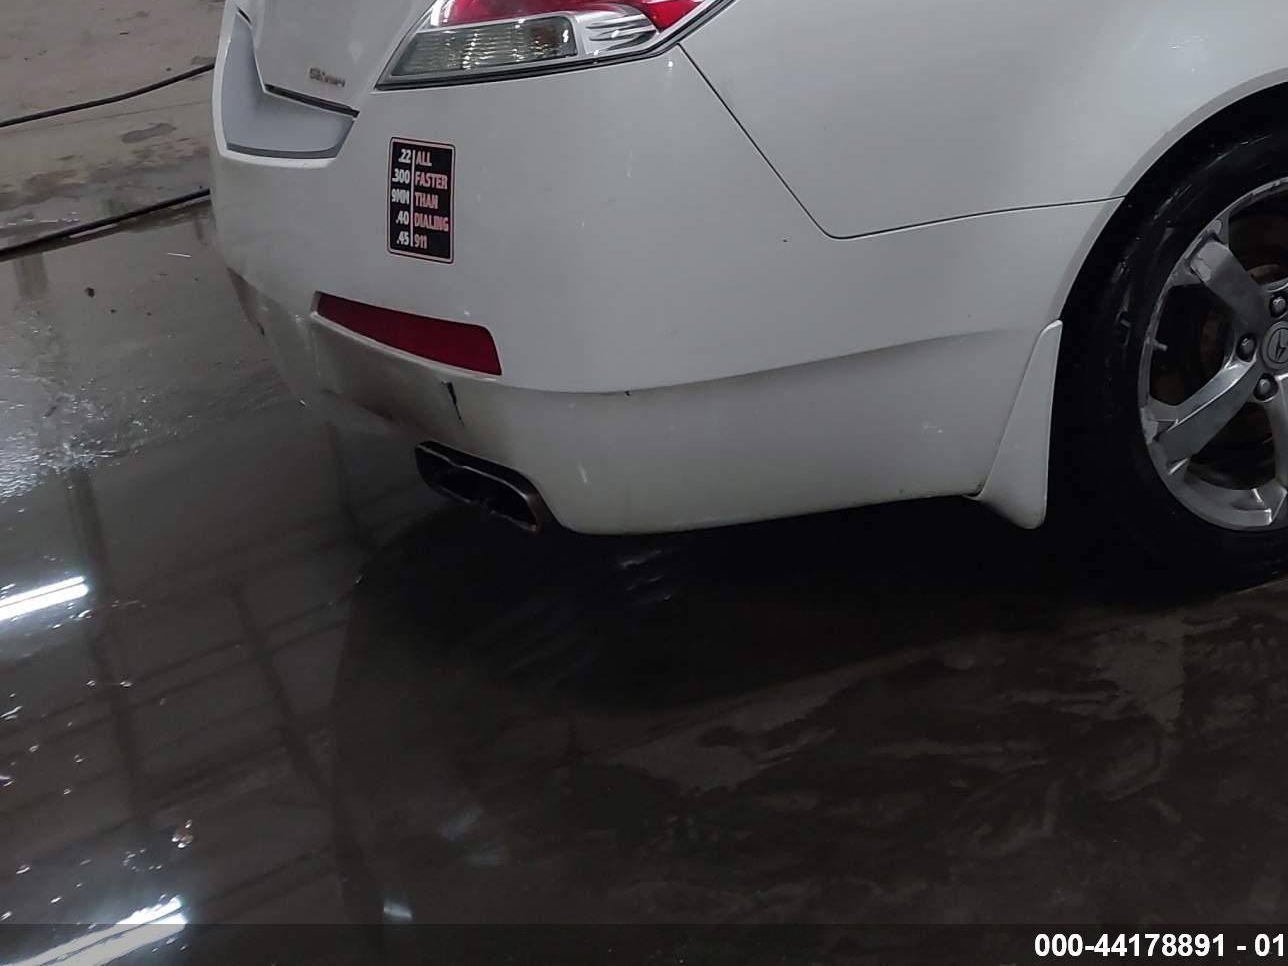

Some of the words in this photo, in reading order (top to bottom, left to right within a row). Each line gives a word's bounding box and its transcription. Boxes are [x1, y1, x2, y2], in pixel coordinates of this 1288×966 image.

[398, 148, 411, 163] .22
[415, 150, 433, 166] ALL
[391, 168, 410, 184] .300
[414, 171, 448, 189] FASTER
[391, 188, 410, 205] 9MM
[414, 191, 439, 209] THAN
[395, 210, 409, 225] .40
[414, 212, 449, 232] DIALING
[396, 230, 409, 246] .45
[414, 233, 428, 249] 911
